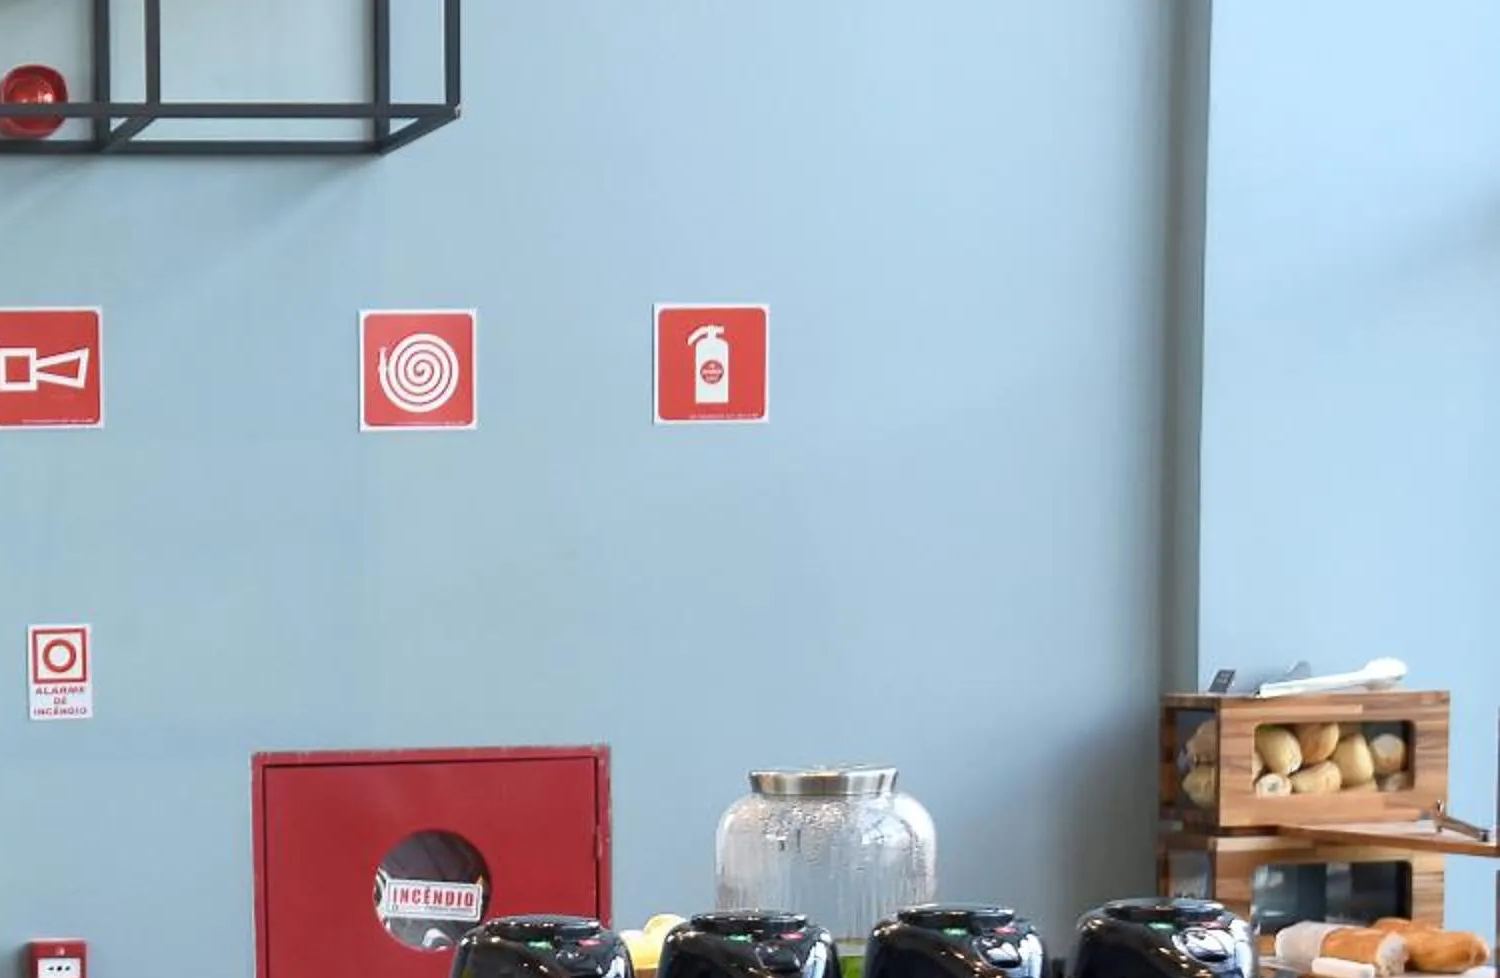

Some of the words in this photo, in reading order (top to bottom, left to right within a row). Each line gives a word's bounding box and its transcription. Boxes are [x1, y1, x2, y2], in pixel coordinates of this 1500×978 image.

[35, 686, 85, 695] ALARME
[53, 697, 67, 705] DE
[33, 705, 88, 715] INCÊNDIO
[392, 886, 475, 907] INCÊNDIO
